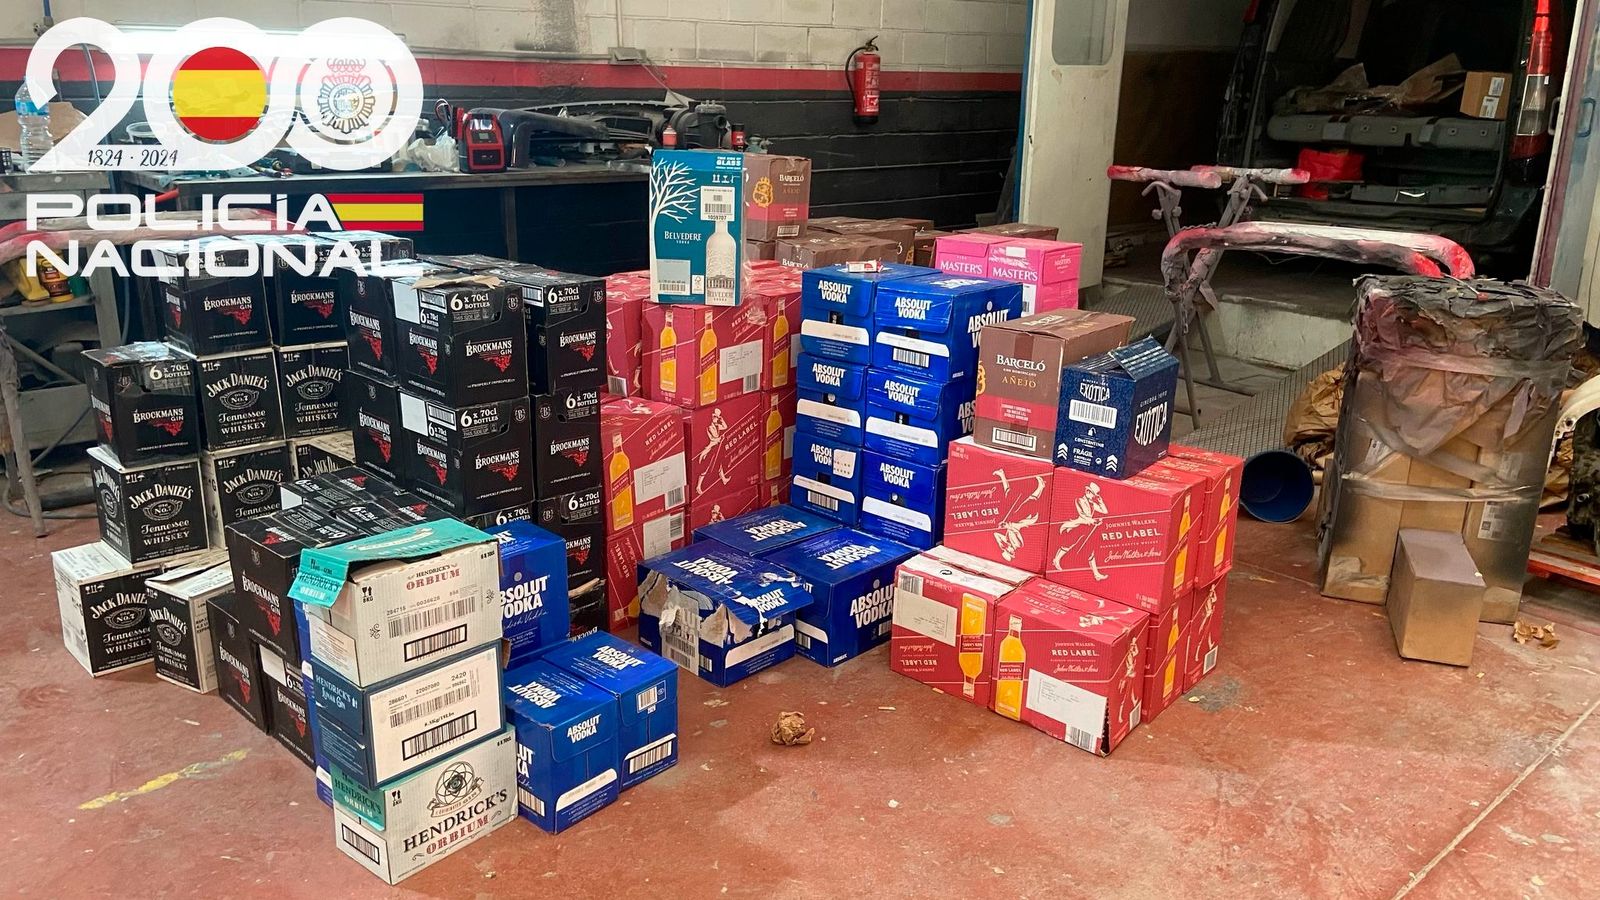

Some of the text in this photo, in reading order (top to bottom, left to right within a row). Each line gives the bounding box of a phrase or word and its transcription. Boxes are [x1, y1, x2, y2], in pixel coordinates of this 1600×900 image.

[779, 174, 805, 182] BARCELÓ
[664, 230, 702, 242] BELVEDERE
[940, 261, 983, 275] MASTER'S
[993, 267, 1038, 281] MASTER'S
[547, 287, 558, 304] 6
[564, 287, 579, 295] 70cl
[818, 279, 853, 295] ABSOLUT
[203, 296, 252, 311] BROCKMANS
[291, 290, 335, 304] BROCKMANS
[450, 293, 463, 311] 6
[471, 293, 489, 301] 70cl
[465, 301, 491, 310] BOTTLES
[559, 294, 580, 302] BOTTLES
[821, 290, 848, 304] VODKA
[895, 297, 933, 311] ABSOLUT
[350, 309, 381, 331] BROCKMANS
[420, 308, 427, 324] 6
[897, 308, 926, 320] VODKA
[968, 309, 1009, 333] ABSOLUT
[409, 332, 438, 350] BROCKMANS
[559, 331, 597, 348] BROCKMANS
[466, 340, 513, 357] BROCKMANS
[500, 348, 512, 356] GIN
[812, 362, 846, 379] ABSOLUT
[996, 354, 1046, 371] BARCELÓ
[149, 363, 189, 380] 6 70cl
[285, 368, 308, 387] JACK
[307, 364, 344, 382] DANIEL'S
[815, 373, 841, 387] VODKA
[206, 372, 270, 398] JACK DANIEL'S
[884, 379, 921, 396] ABSOLUT
[1002, 375, 1037, 388] AÑEJO
[566, 392, 576, 409] 6
[582, 391, 597, 400] 70cl
[887, 391, 916, 406] VODKA
[1079, 382, 1110, 402] EXÓTICA
[294, 401, 339, 412] Tennessee
[577, 398, 598, 407] BOTTLES
[132, 408, 184, 424] BROCKMANS
[218, 409, 266, 424] Tennessee
[296, 411, 339, 423] WHISKEY
[359, 411, 391, 436] BROCKMANS
[460, 410, 473, 427] 6
[479, 407, 498, 416] 70cl
[473, 415, 499, 425] BOTTLES
[1134, 401, 1168, 447] EXÓTICA
[220, 421, 267, 435] WHISKEY
[428, 422, 435, 437] 6
[644, 420, 675, 446] RED LABEL
[724, 422, 759, 451] RED LABEL
[417, 442, 447, 463] BROCKMANS
[550, 437, 590, 455] BROCKMANS
[1073, 447, 1093, 457] FRÁGIL
[475, 450, 520, 470] BROCKMANS
[507, 458, 520, 466] GIN
[880, 462, 916, 480] ABSOLUT
[223, 468, 284, 494] JACK DANIEL'S
[883, 474, 910, 489] VODKA
[128, 483, 194, 509] JACK DANIEL'S
[568, 495, 579, 511] 6
[585, 491, 600, 500] 70cl
[580, 499, 600, 508] BOTTLES
[235, 502, 281, 518] Tennessee
[495, 507, 530, 526] 6 70cl
[981, 507, 999, 517] RED
[140, 520, 190, 535] Tennessee
[744, 518, 793, 535] VODKA
[750, 520, 807, 541] ABSOLUT
[975, 518, 996, 526] JOHNNIE
[1106, 522, 1131, 530] JOHNNIE
[143, 531, 190, 546] WHISKEY
[1101, 530, 1123, 541] RED
[580, 543, 592, 551] GIN
[817, 544, 866, 562] VODKA
[825, 545, 882, 570] ABSOLUT
[416, 564, 451, 579] HENDRICK'S
[672, 560, 733, 585] ABSOLUT
[693, 557, 739, 578] VODKA
[406, 568, 461, 591] ORBIUM
[242, 574, 280, 608] BROCKMANS
[90, 592, 148, 619] JACK DANIE
[270, 604, 281, 616] GIN
[149, 607, 188, 636] JACK DANIEL'S
[156, 640, 187, 660] Tennessee
[596, 645, 647, 667] ABSOLUT
[158, 655, 188, 671] WHISKEY
[219, 646, 250, 678] BROCKMANS
[592, 652, 629, 670] VODKA
[286, 674, 293, 689] 6
[451, 671, 467, 682] 2420
[315, 674, 351, 702] HENDRICK'S
[509, 684, 557, 709] ABSOLUT
[525, 681, 562, 702] VODKA
[277, 692, 305, 718] BROCKMANS
[567, 713, 601, 737] ABSOLUT
[570, 725, 598, 743] VODKA
[335, 778, 382, 815] HENDRICK'S
[403, 788, 508, 853] HENDRICK'S
[426, 815, 490, 855] ORBIUM
